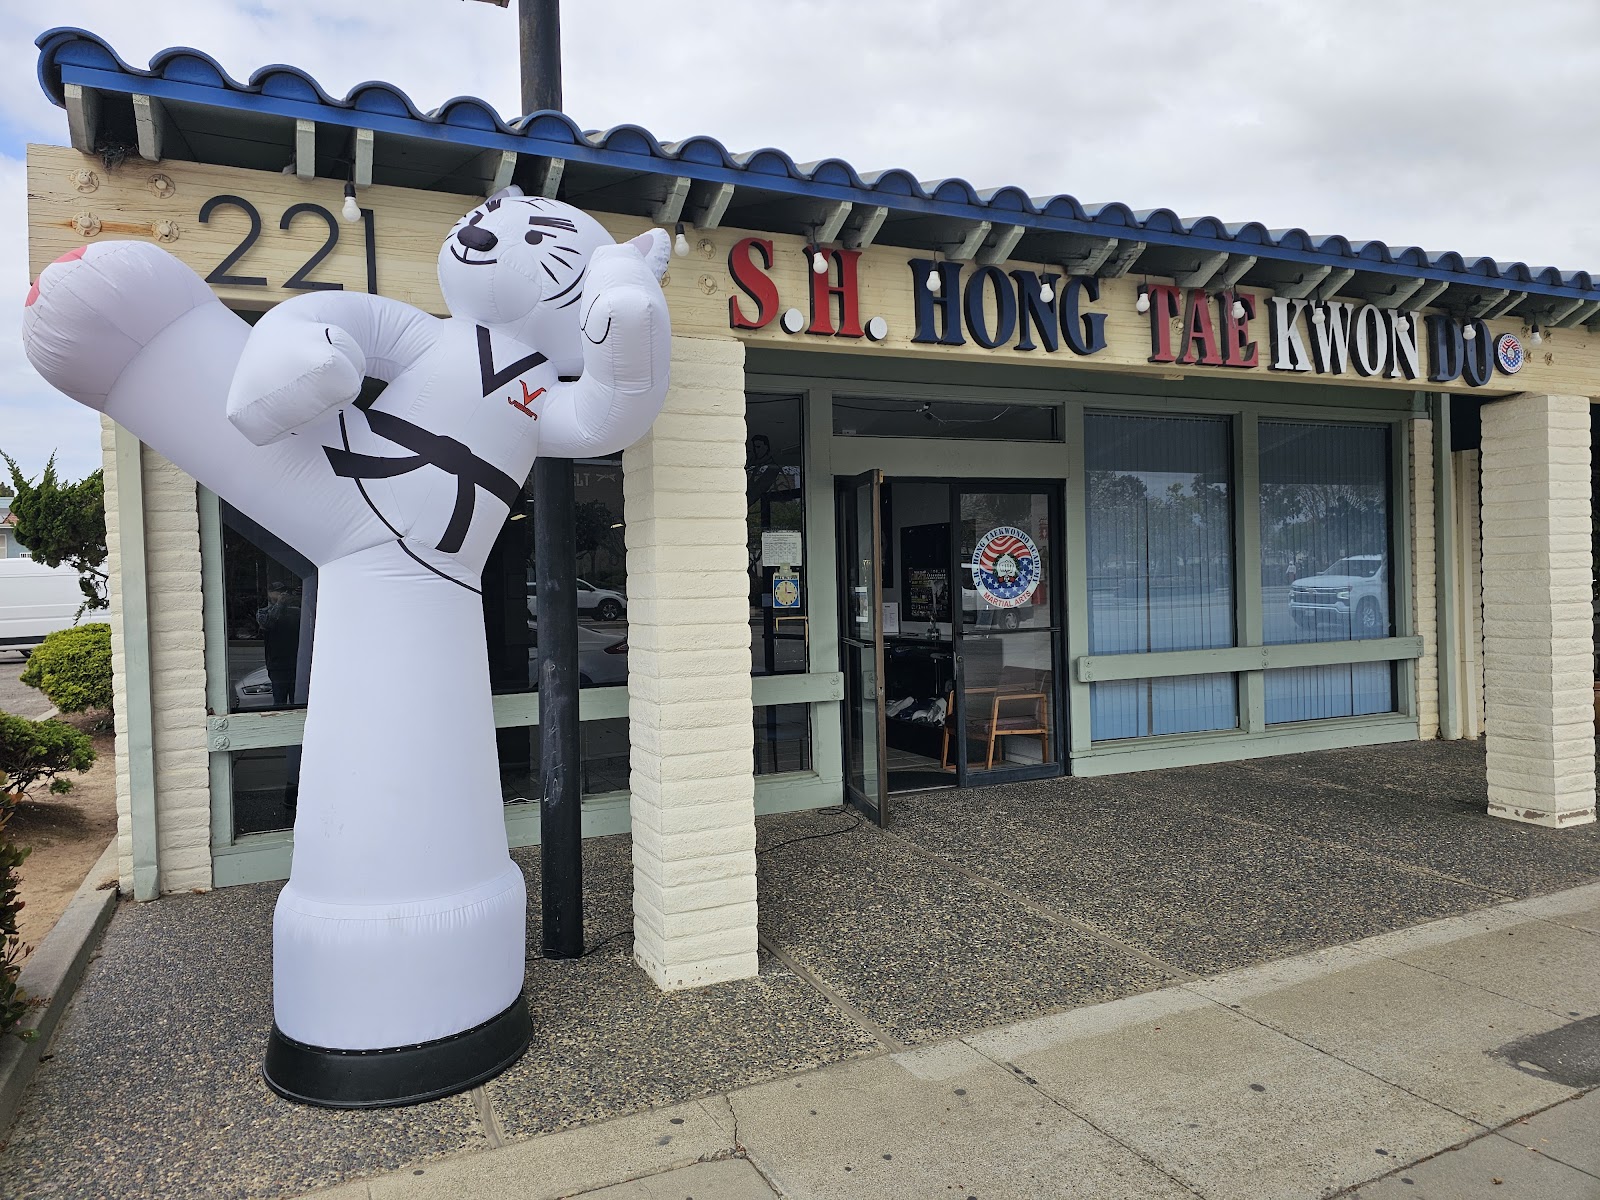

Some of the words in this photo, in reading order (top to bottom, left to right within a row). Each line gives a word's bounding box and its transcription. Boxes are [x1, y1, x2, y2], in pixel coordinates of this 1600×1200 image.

[198, 194, 377, 294] 221
[728, 237, 888, 342] S.H.
[907, 258, 1109, 355] HONG
[1147, 284, 1259, 367] TAE
[1266, 297, 1420, 379] KWON
[1424, 314, 1494, 387] DO
[973, 541, 986, 565] HONG
[985, 527, 1030, 544] TAEKWONDO
[983, 591, 1014, 607] MARTIAL
[1014, 590, 1031, 606] ARTS
